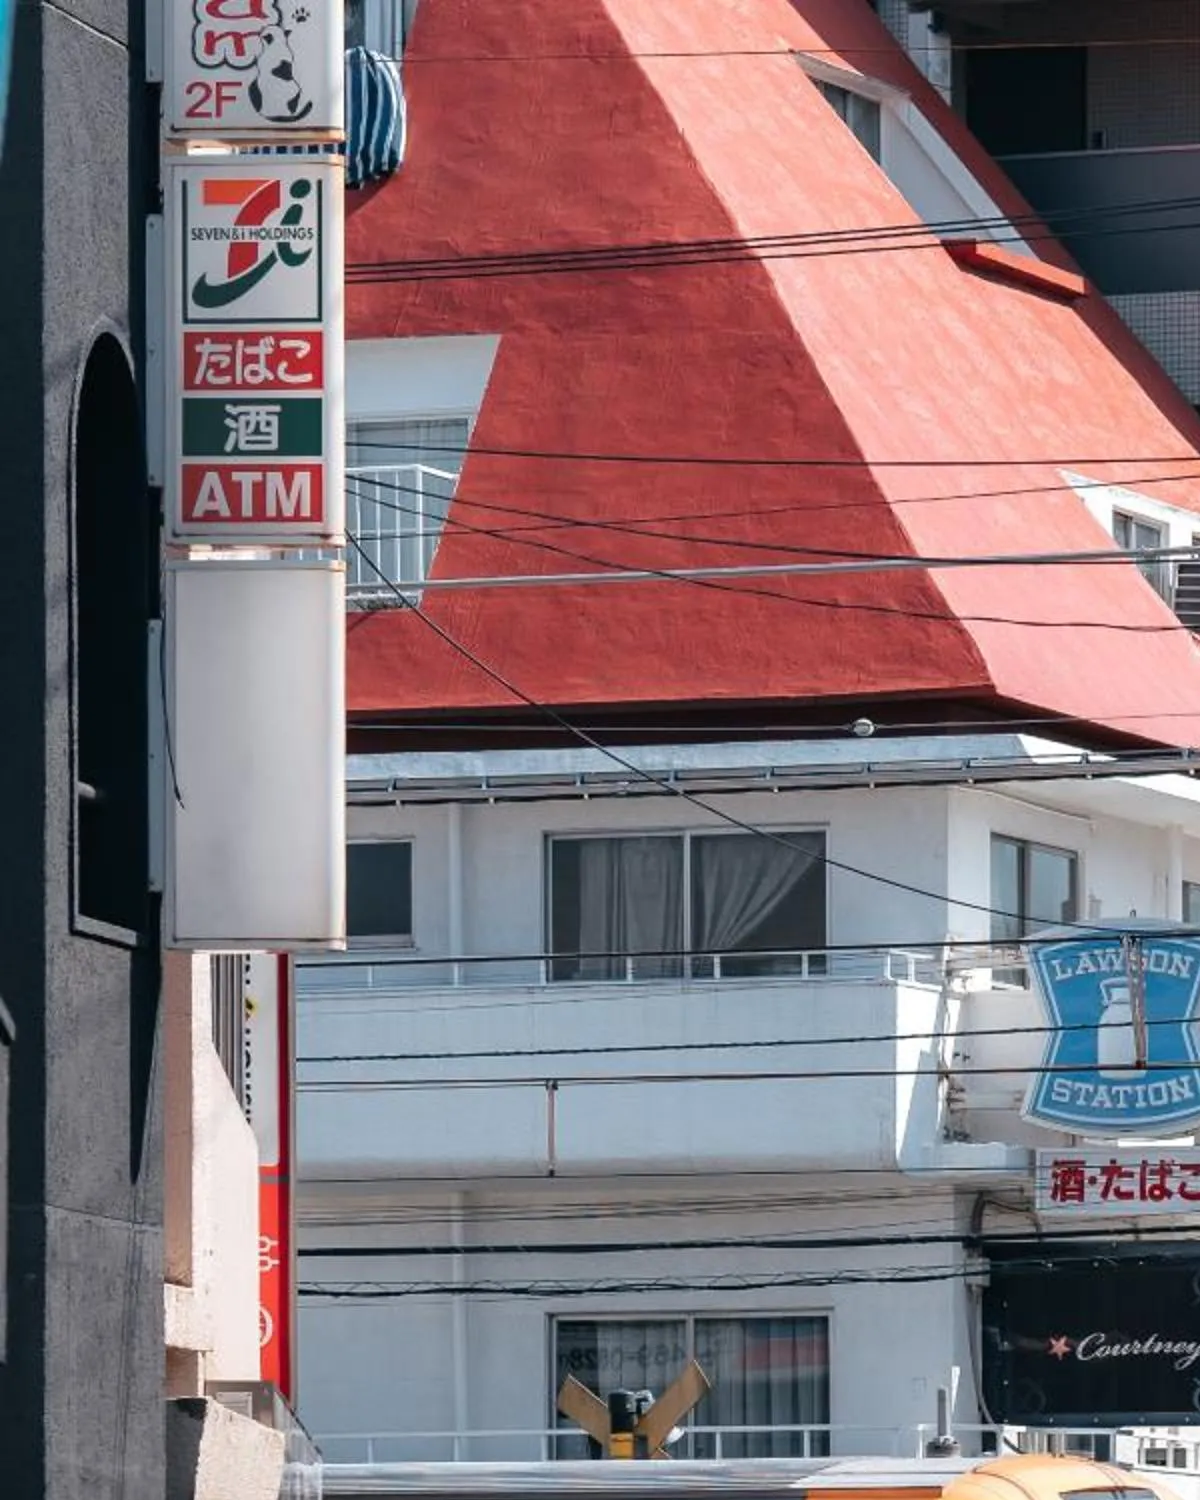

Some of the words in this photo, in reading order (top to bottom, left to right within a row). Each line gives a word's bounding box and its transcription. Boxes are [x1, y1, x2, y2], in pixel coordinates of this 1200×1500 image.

[185, 81, 243, 119] 2F
[249, 227, 314, 240] HOLDINGS
[193, 335, 313, 386] たばこ
[223, 403, 283, 454] 酒
[191, 471, 312, 518] ATM
[1051, 947, 1194, 981] LAWSON
[1051, 1075, 1195, 1109] STATION
